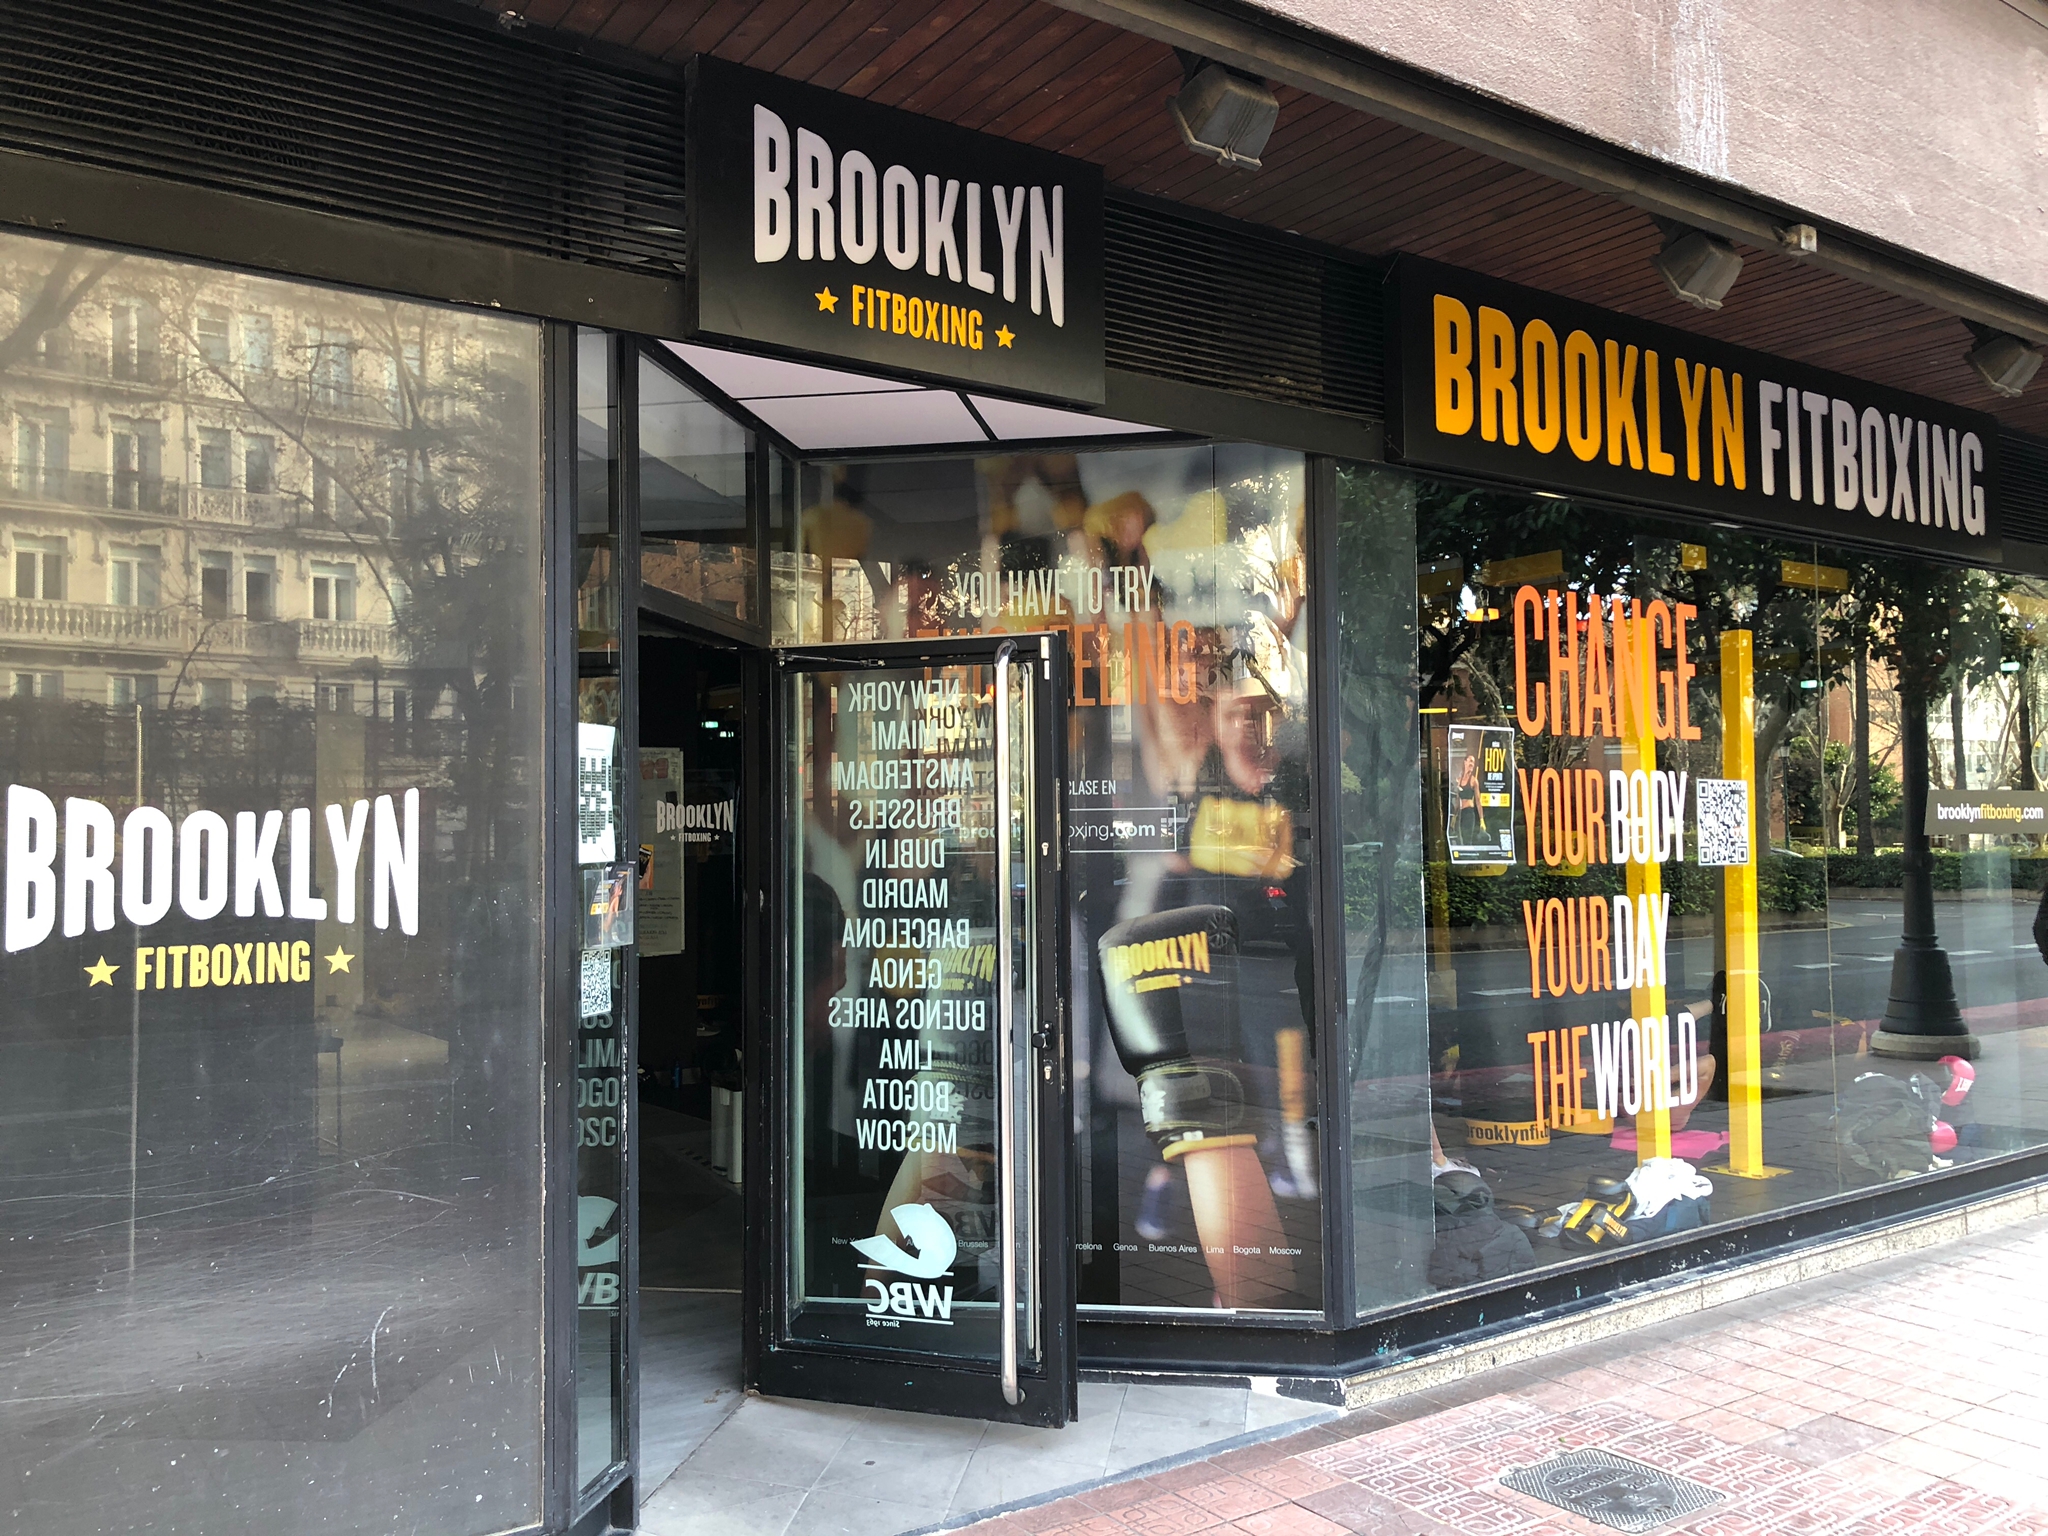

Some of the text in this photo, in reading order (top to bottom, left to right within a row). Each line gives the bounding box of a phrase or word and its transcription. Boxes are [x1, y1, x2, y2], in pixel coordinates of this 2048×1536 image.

[754, 103, 1065, 328] BROOKLYN
[851, 284, 985, 350] FITBOXING
[1433, 293, 1986, 537] BROOKLYN FITBOXING
[956, 564, 1155, 619] YOU HAVE TO TRY
[1045, 619, 1198, 707] ELING
[1514, 584, 1702, 741] CHANGE
[1102, 779, 1117, 795] EN
[1484, 747, 1507, 772] HOY
[657, 799, 734, 833] BROOKLYN
[678, 832, 712, 843] FITBOXING
[1517, 767, 1688, 867] YOUR BODY
[1937, 802, 2045, 823] brooklynfitboxing.com
[5, 783, 420, 953] BROOKLYN
[135, 940, 312, 991] FITBOXING
[1522, 892, 1670, 999] YOUR DAY
[1526, 1012, 1698, 1135] THE WORLD
[958, 1239, 989, 1249] Brussels
[1075, 1241, 1103, 1251] rcelona
[1113, 1242, 1138, 1252] Genoa
[1148, 1243, 1177, 1253] Buenos
[1178, 1244, 1198, 1253] Aires
[1206, 1244, 1225, 1254] Lima
[1233, 1245, 1261, 1255] Bogota
[1269, 1246, 1302, 1255] Moscow
